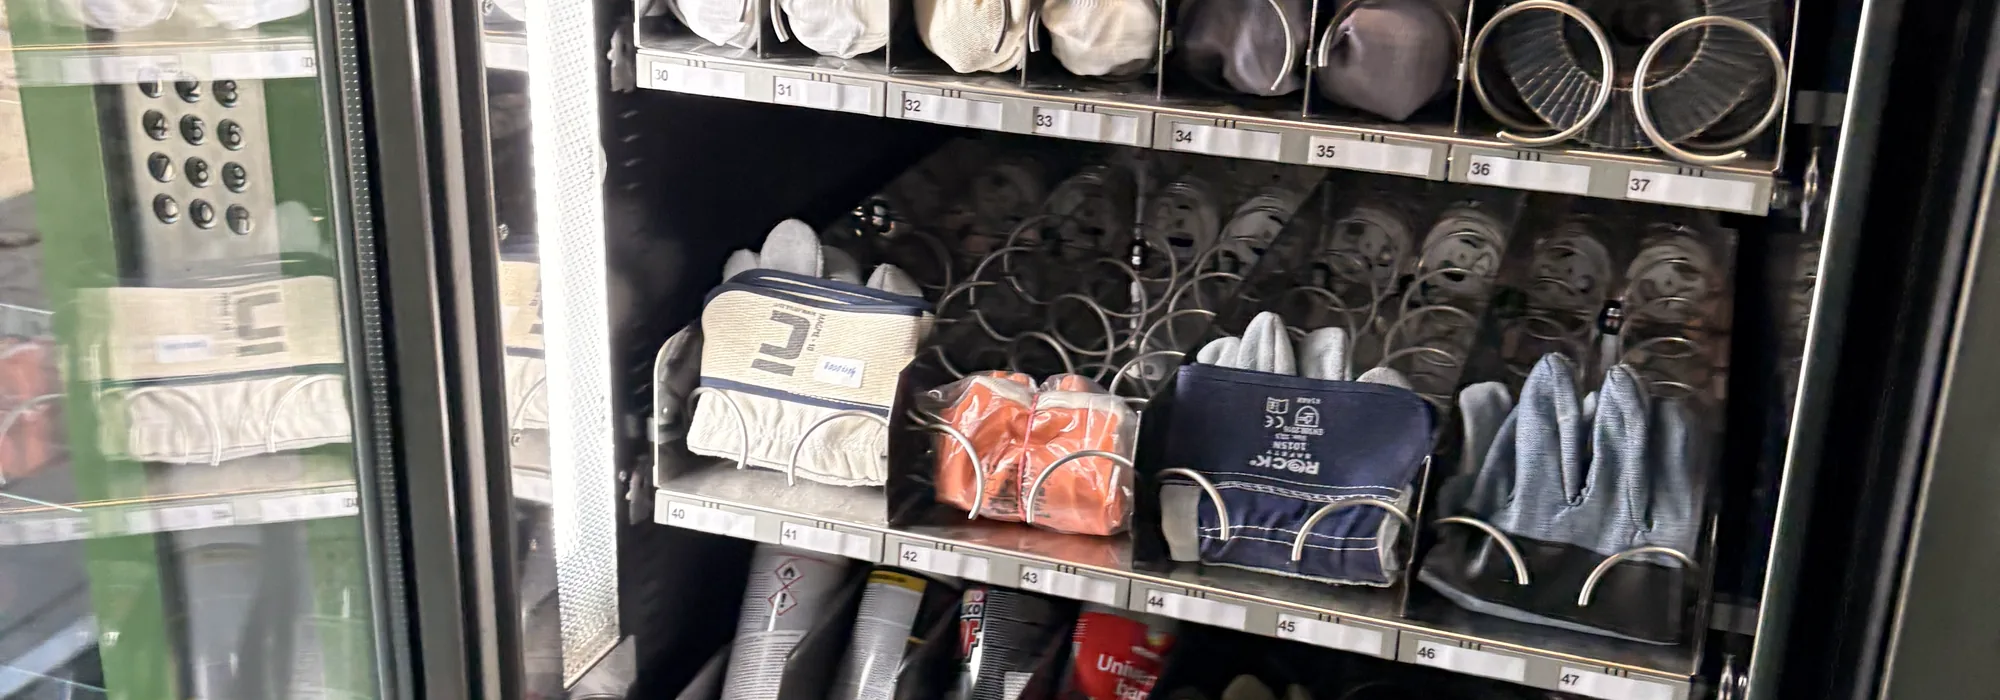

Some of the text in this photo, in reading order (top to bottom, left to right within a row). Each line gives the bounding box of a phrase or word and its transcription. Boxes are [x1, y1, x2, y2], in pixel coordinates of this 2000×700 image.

[655, 69, 668, 81] 30
[777, 84, 792, 97] 31
[905, 99, 921, 112] 32
[1036, 115, 1053, 127] 33
[1175, 130, 1192, 144] 34
[1316, 145, 1335, 158] 35
[1471, 162, 1490, 176] 36
[1630, 178, 1650, 192] 37
[1266, 450, 1311, 458] SAFETY
[671, 508, 685, 519] 40
[783, 528, 797, 540] 41
[903, 551, 918, 562] 42
[1022, 571, 1038, 584] 43
[1148, 596, 1164, 608] 44
[1278, 620, 1295, 633] 45
[1417, 647, 1436, 660] 46
[1560, 674, 1579, 687] 47
